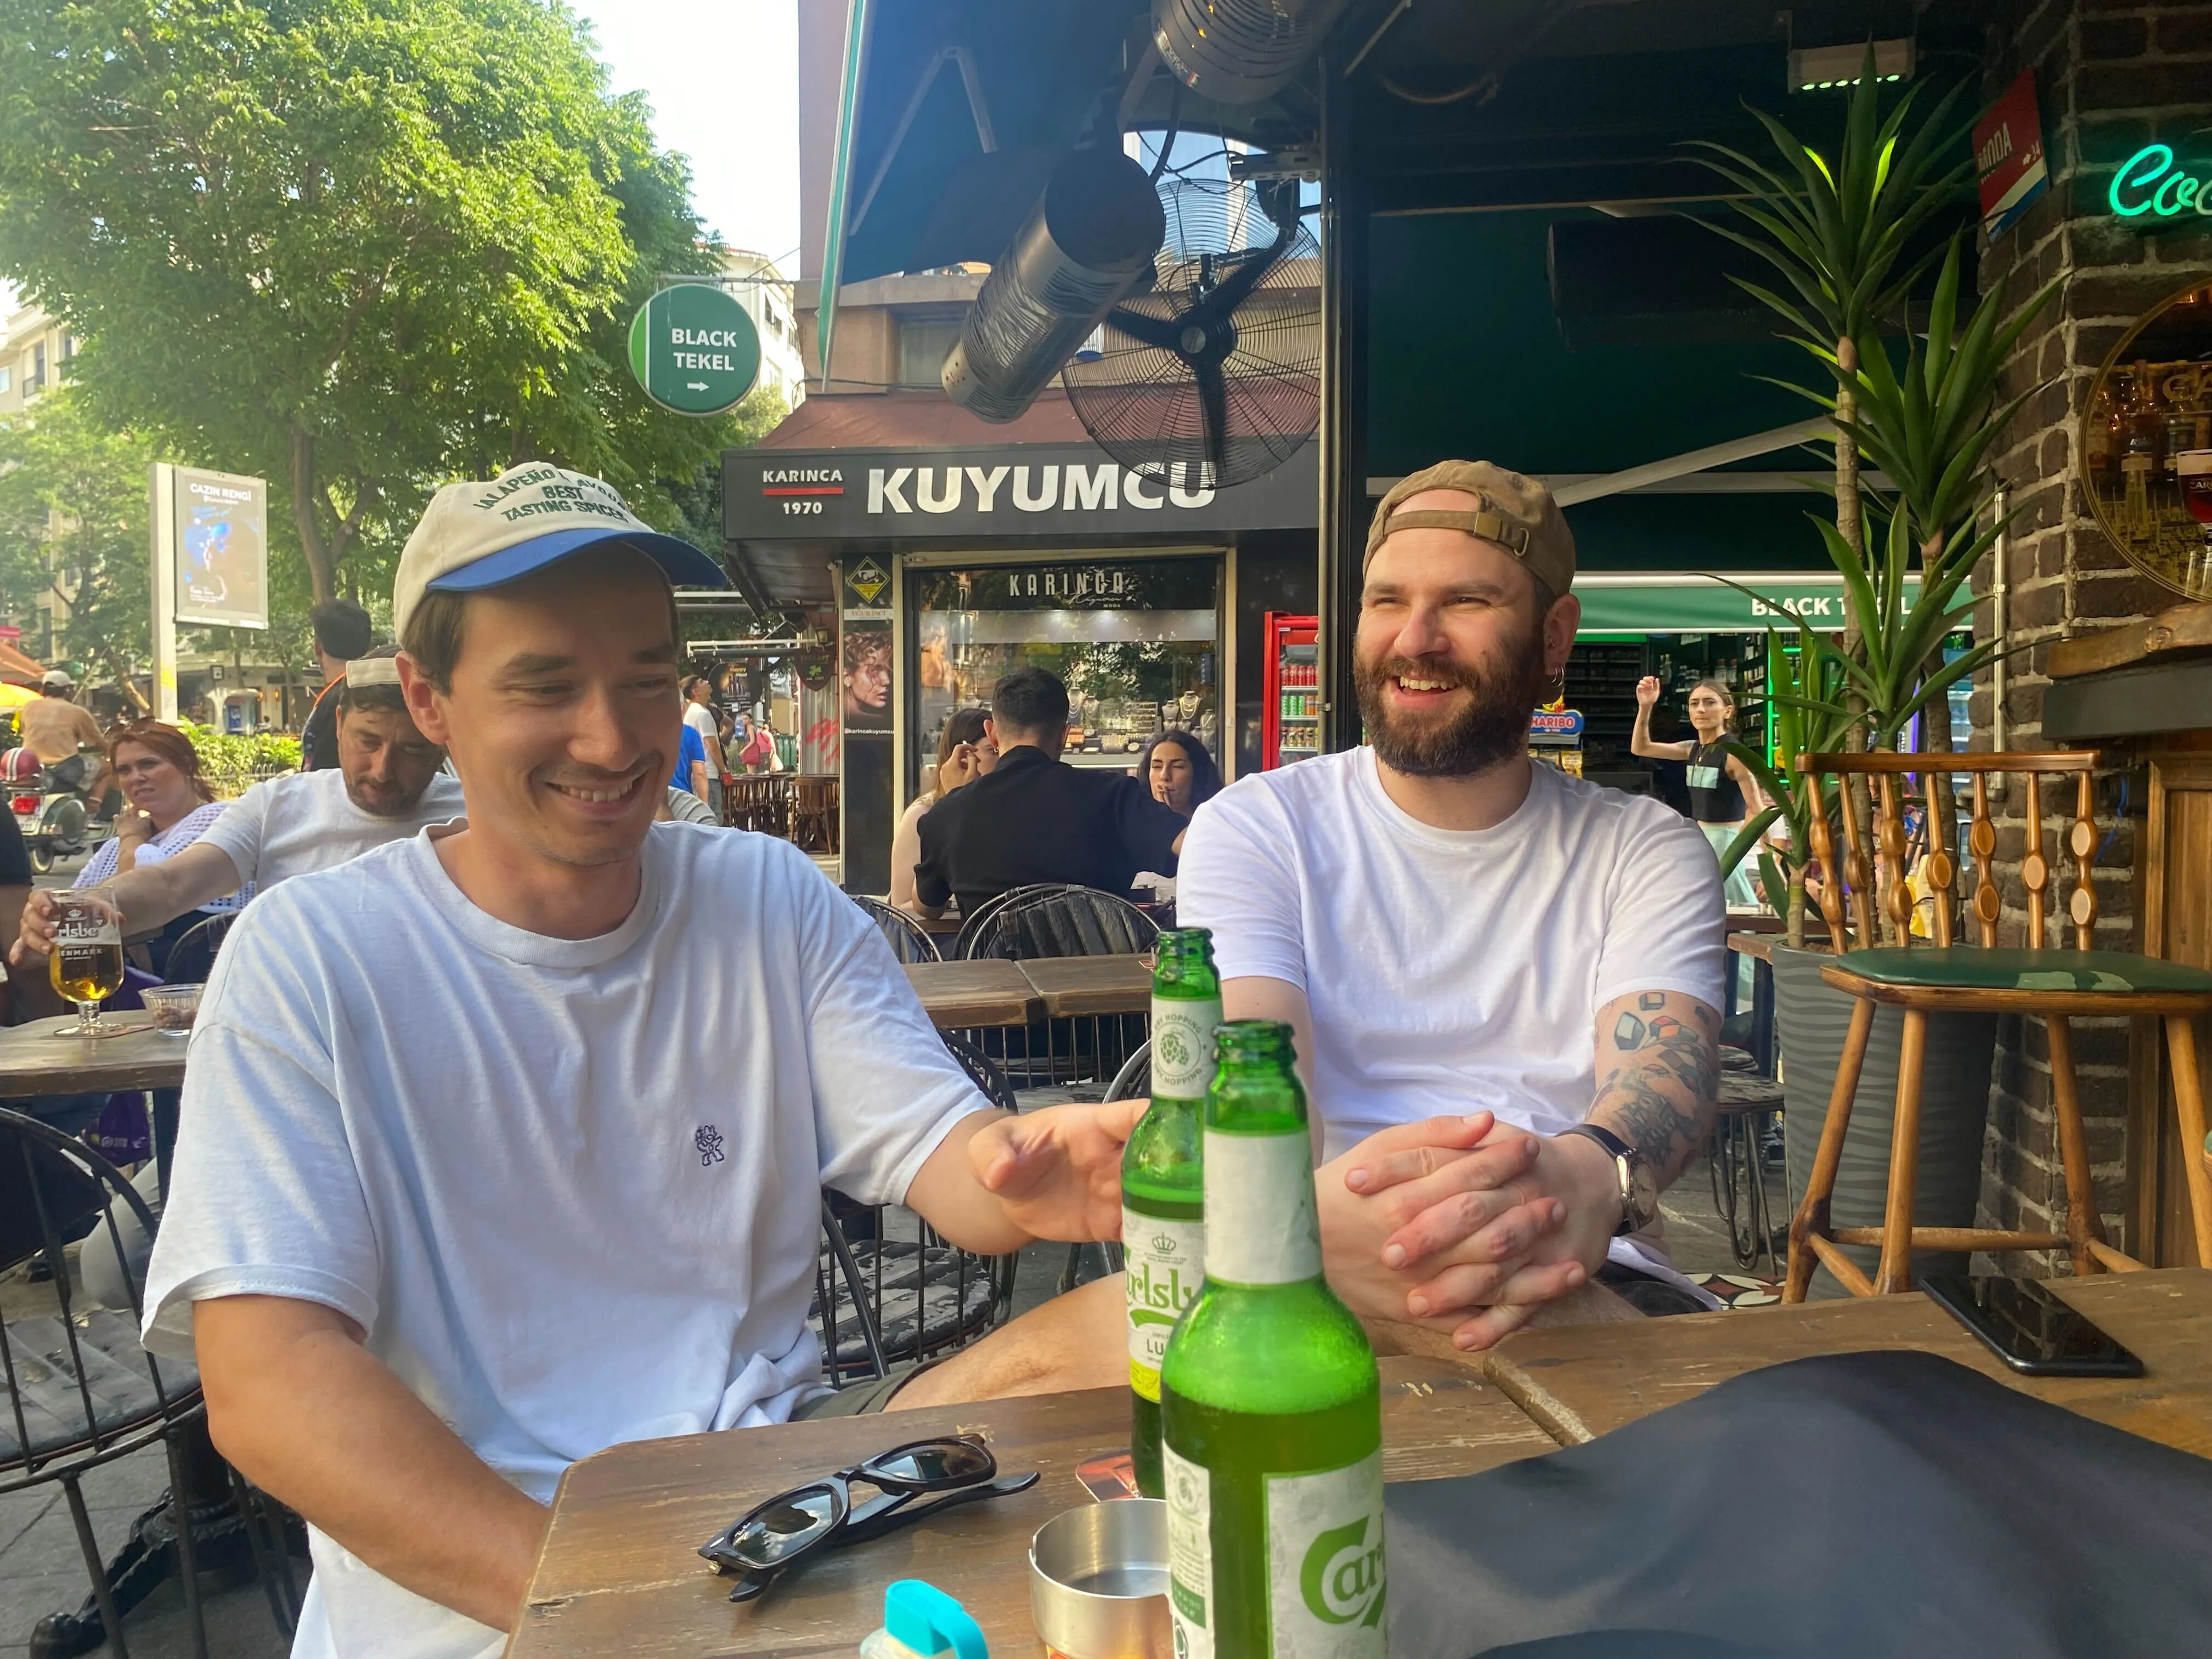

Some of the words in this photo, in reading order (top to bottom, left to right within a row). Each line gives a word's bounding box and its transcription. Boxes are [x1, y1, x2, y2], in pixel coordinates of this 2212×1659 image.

[672, 328, 737, 347] BLACK
[673, 352, 735, 371] TEKEL
[763, 469, 843, 483] KARINCA
[189, 483, 221, 497] CAZIN
[541, 485, 584, 500] BEST
[867, 461, 1216, 514] KUYUMCU
[500, 500, 572, 522] TASTING
[573, 500, 629, 523] SPICES
[783, 501, 823, 515] 1970
[1009, 572, 1124, 596] KARINCA
[1751, 597, 1831, 616] BLACK
[1530, 715, 1575, 729] HARIBO
[60, 948, 103, 957] ENMARK
[1165, 1013, 1203, 1034] HOPPING
[1164, 1067, 1203, 1085] HOPPING
